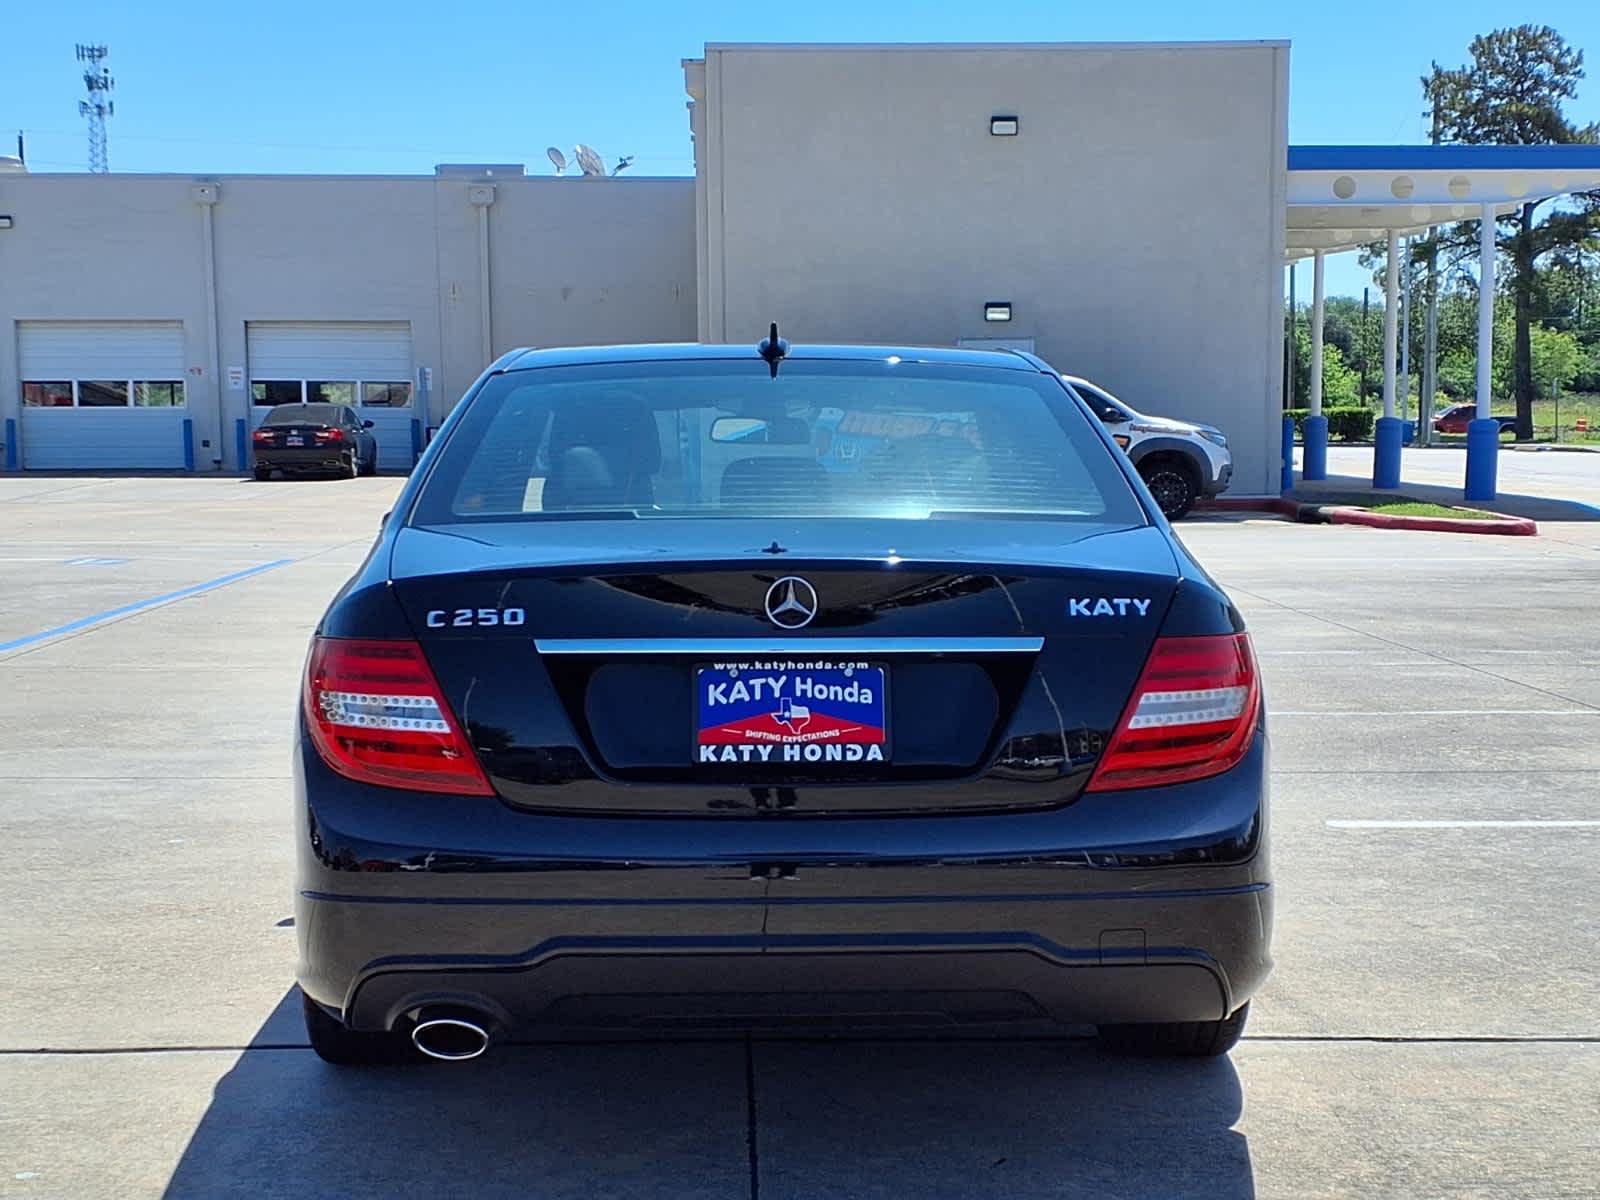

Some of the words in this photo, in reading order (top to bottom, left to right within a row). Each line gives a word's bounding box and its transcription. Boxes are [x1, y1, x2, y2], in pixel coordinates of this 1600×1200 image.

[1069, 598, 1151, 616] KATY
[714, 661, 869, 671] www.katyhonda.com
[707, 675, 787, 706] KATY
[795, 677, 873, 704] Honda
[745, 729, 781, 742] SHIFTING
[782, 729, 840, 743] EXPECTATIONS
[700, 744, 774, 762] KATY
[783, 744, 884, 762] HONDA
